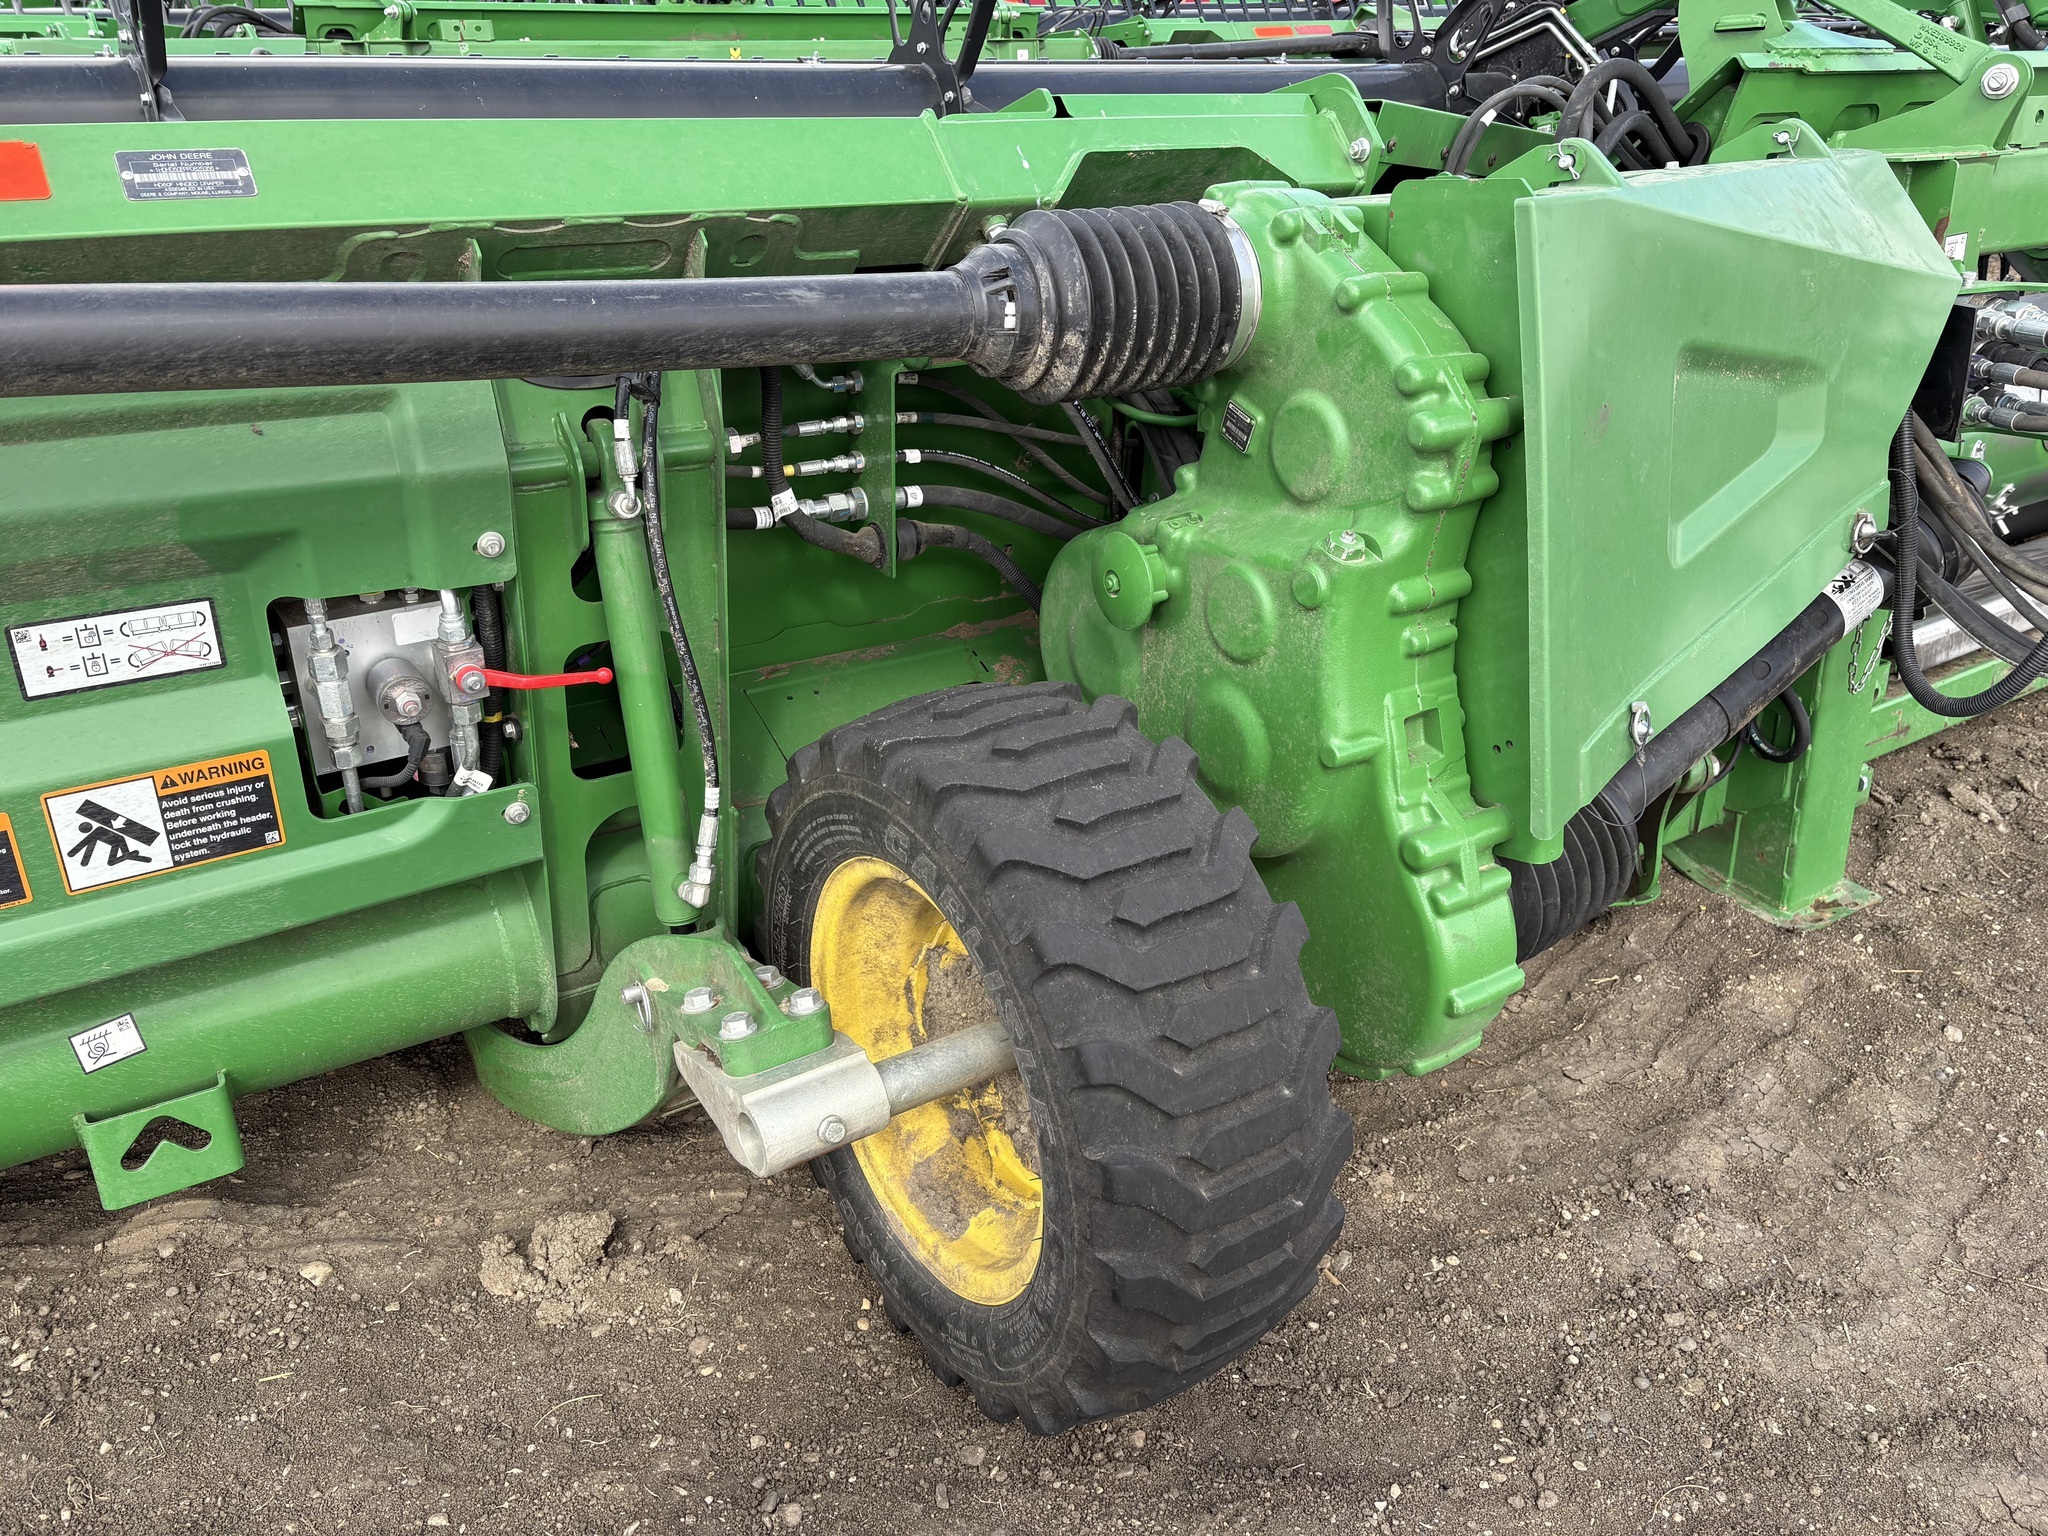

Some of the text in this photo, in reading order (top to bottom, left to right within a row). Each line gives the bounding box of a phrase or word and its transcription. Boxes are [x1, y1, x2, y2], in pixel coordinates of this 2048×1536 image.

[149, 152, 213, 161] JOHN DEERE
[667, 596, 680, 629] exceeds
[684, 655, 694, 675] (3300
[178, 757, 265, 785] WARNING
[161, 797, 188, 809] Avoid
[190, 789, 225, 803] serious
[226, 784, 253, 796] injury
[163, 794, 259, 820] death from crushing.
[166, 809, 236, 830] Before working
[168, 811, 273, 840] underneath the header,
[171, 826, 252, 850] lock the hydraulic
[174, 848, 210, 862] system.
[783, 893, 794, 925] SERVICE
